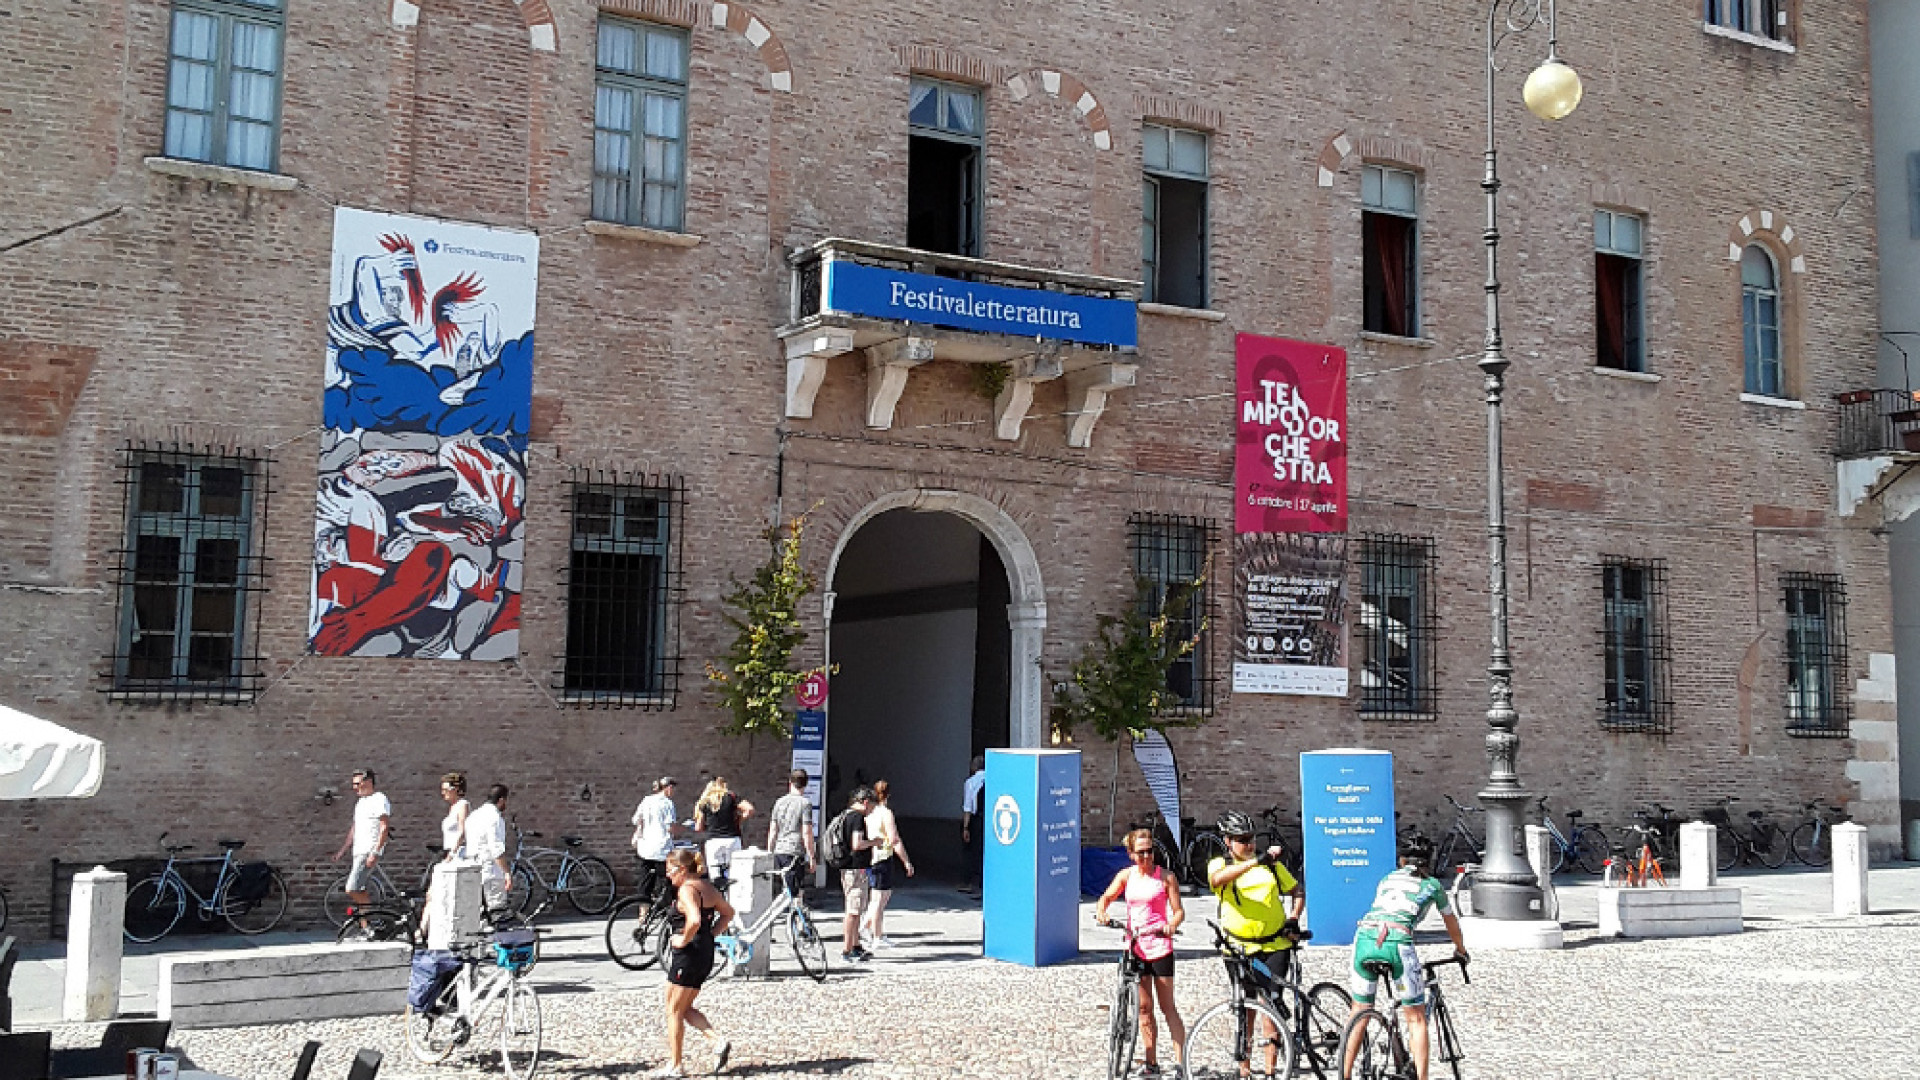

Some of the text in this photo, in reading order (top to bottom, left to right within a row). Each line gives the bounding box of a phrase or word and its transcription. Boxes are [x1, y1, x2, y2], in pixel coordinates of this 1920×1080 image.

[889, 281, 1082, 329] Festivaletteratura
[1265, 433, 1311, 460] CHE
[1274, 456, 1333, 485] STRA
